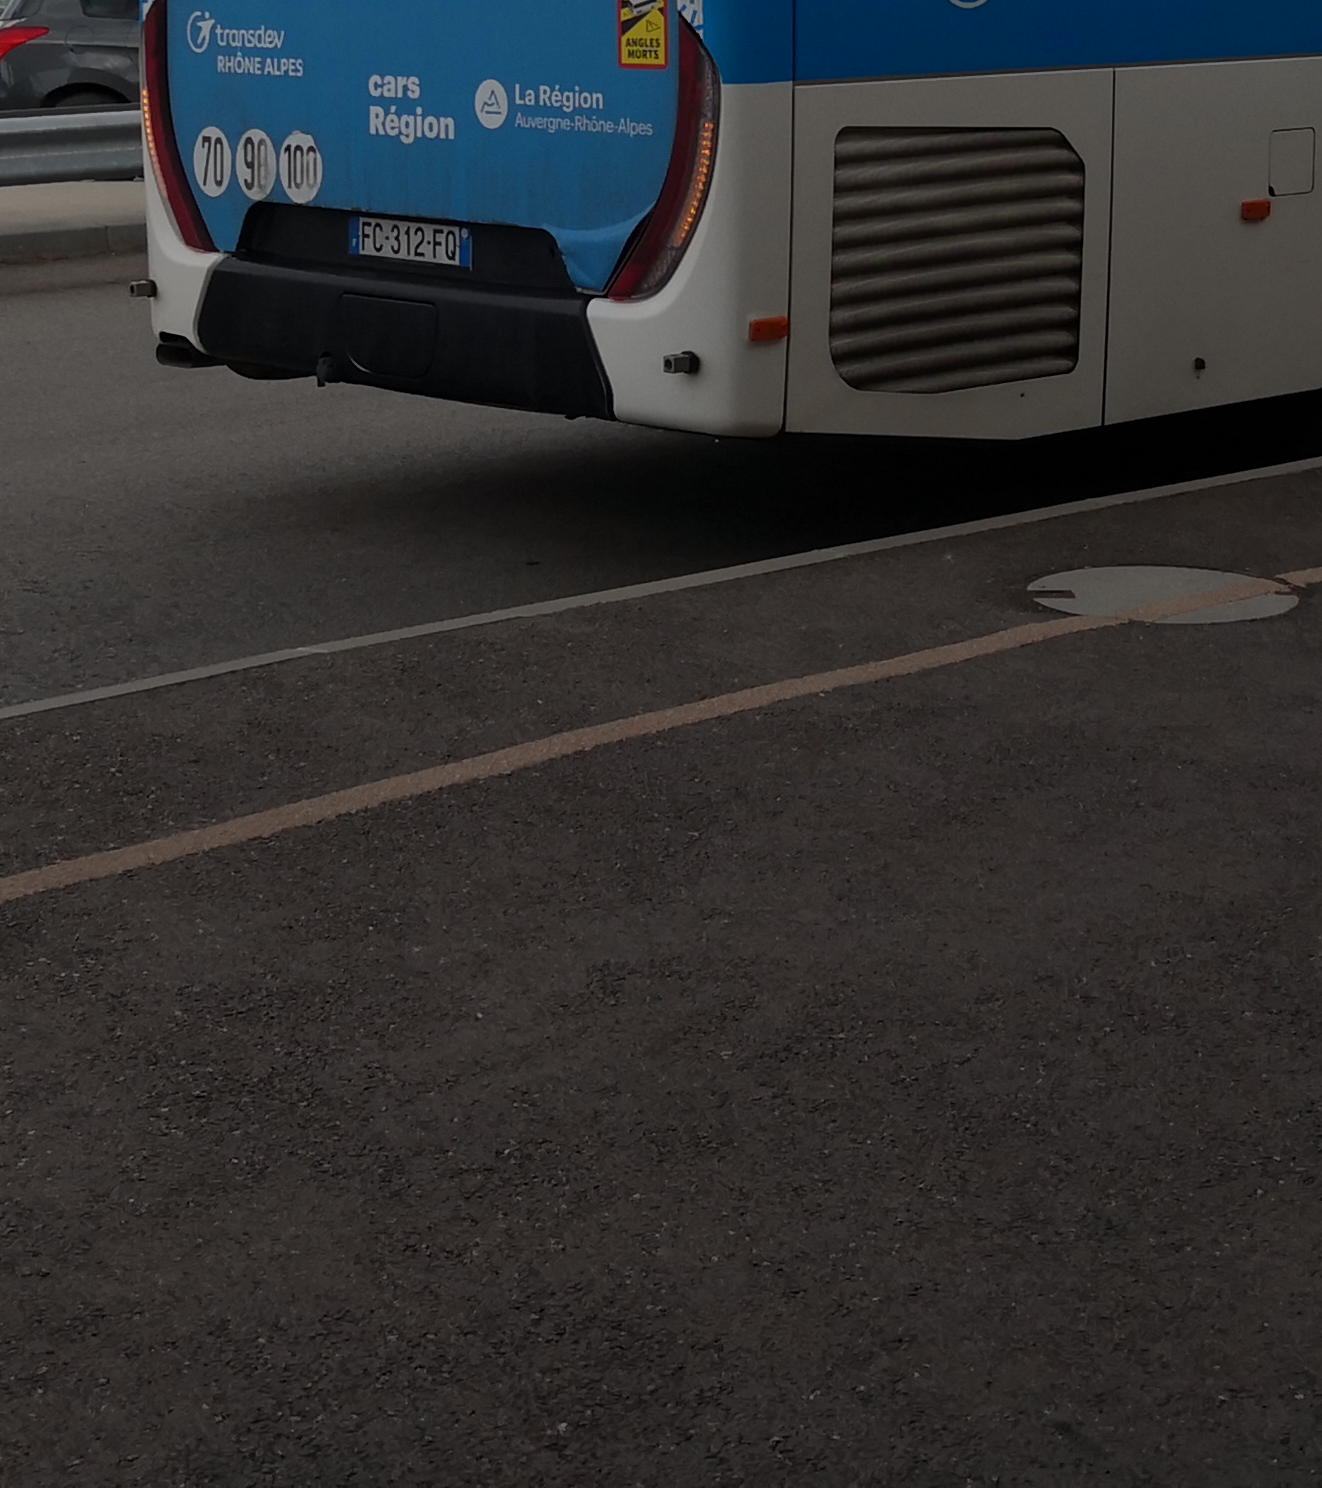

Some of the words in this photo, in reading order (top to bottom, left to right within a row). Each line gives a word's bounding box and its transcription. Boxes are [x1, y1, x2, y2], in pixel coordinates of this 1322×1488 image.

[215, 24, 285, 49] transdev
[625, 38, 661, 48] ANGLES
[217, 51, 262, 75] RHÔNE
[264, 57, 304, 77] ALPES
[627, 49, 659, 59] MORTS
[368, 74, 420, 99] cars
[514, 84, 535, 106] La
[539, 85, 604, 112] Région
[369, 105, 455, 144] Région
[514, 112, 653, 137] Auvergne-Rhône-Alpes
[202, 136, 224, 187] 70
[244, 137, 268, 191] 90
[284, 144, 317, 189] 100
[361, 221, 457, 262] FC-312-FQ
